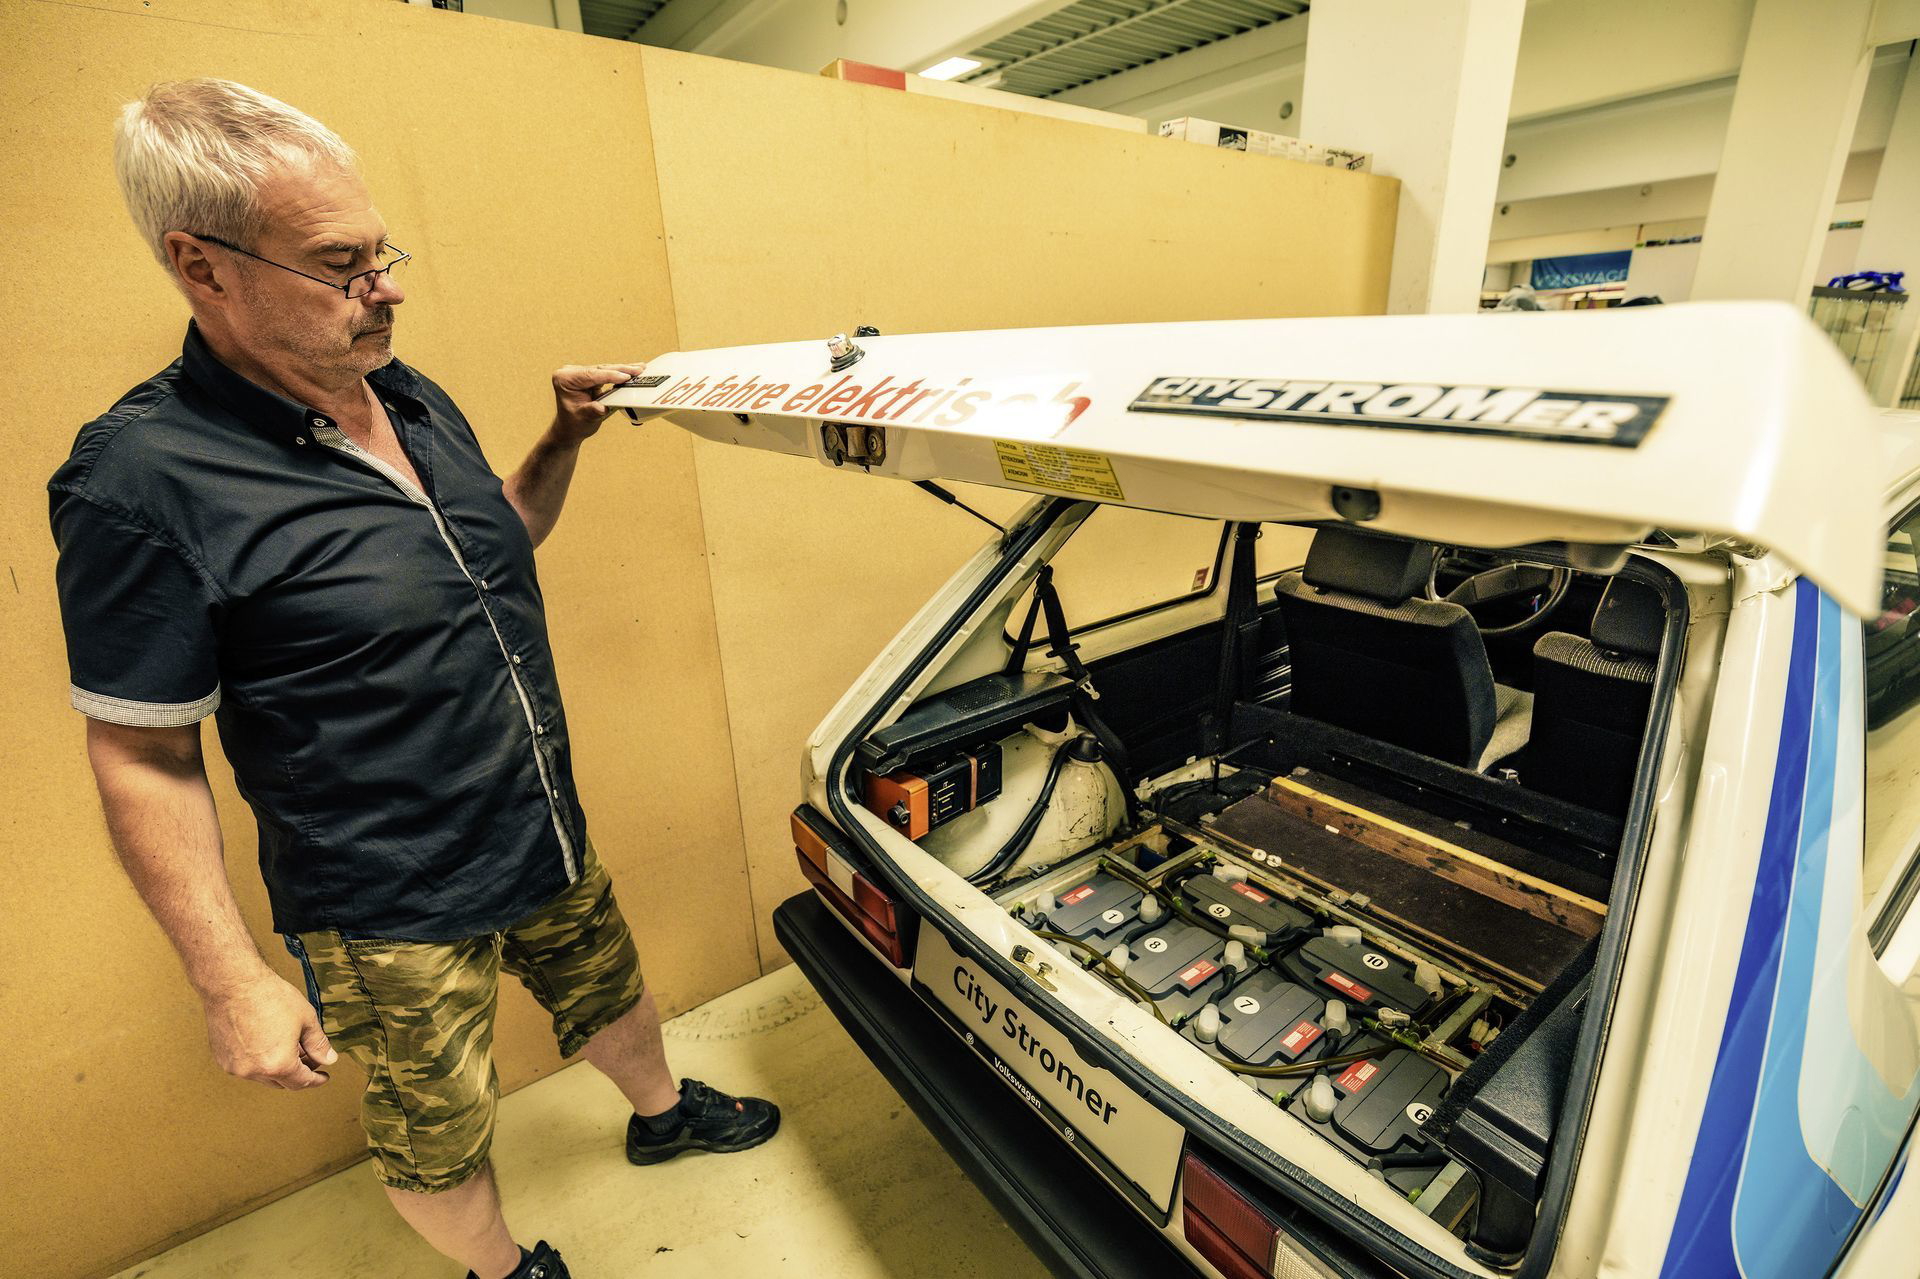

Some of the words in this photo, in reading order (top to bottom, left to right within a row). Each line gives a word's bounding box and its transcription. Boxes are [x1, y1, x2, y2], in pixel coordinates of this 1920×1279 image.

[651, 376, 710, 405] Ich
[692, 374, 791, 411] fahre
[781, 374, 1092, 439] elektrish
[1149, 940, 1161, 950] 8
[1367, 955, 1384, 967] 10
[1239, 999, 1254, 1008] 7
[953, 965, 999, 1024] City
[1002, 1007, 1118, 1125] Stromer
[994, 1056, 1041, 1109] Volkswagen
[1414, 1108, 1430, 1122] 6
